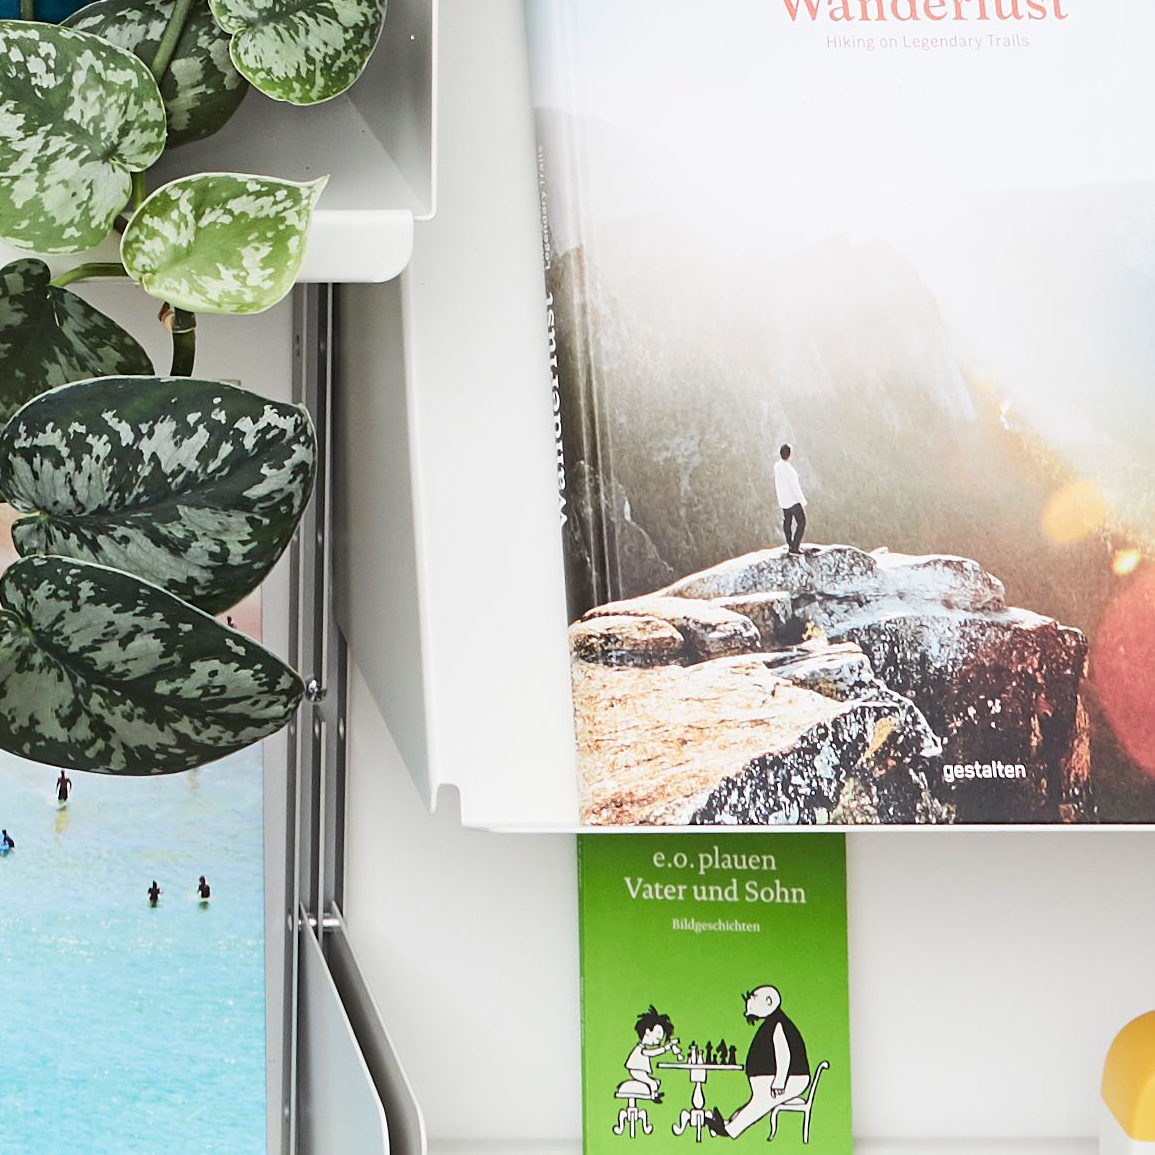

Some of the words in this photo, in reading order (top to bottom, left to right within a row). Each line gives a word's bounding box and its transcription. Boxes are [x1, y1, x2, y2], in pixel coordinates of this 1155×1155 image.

[826, 35, 875, 51] Hiking
[879, 37, 898, 48] on
[903, 35, 982, 52] Legendary
[988, 34, 1030, 47] Trails
[943, 760, 1026, 782] gestalten
[624, 877, 687, 901] Vater
[693, 879, 739, 902] und
[745, 880, 806, 904] Sohn
[672, 918, 761, 933] Bildgeschichten
